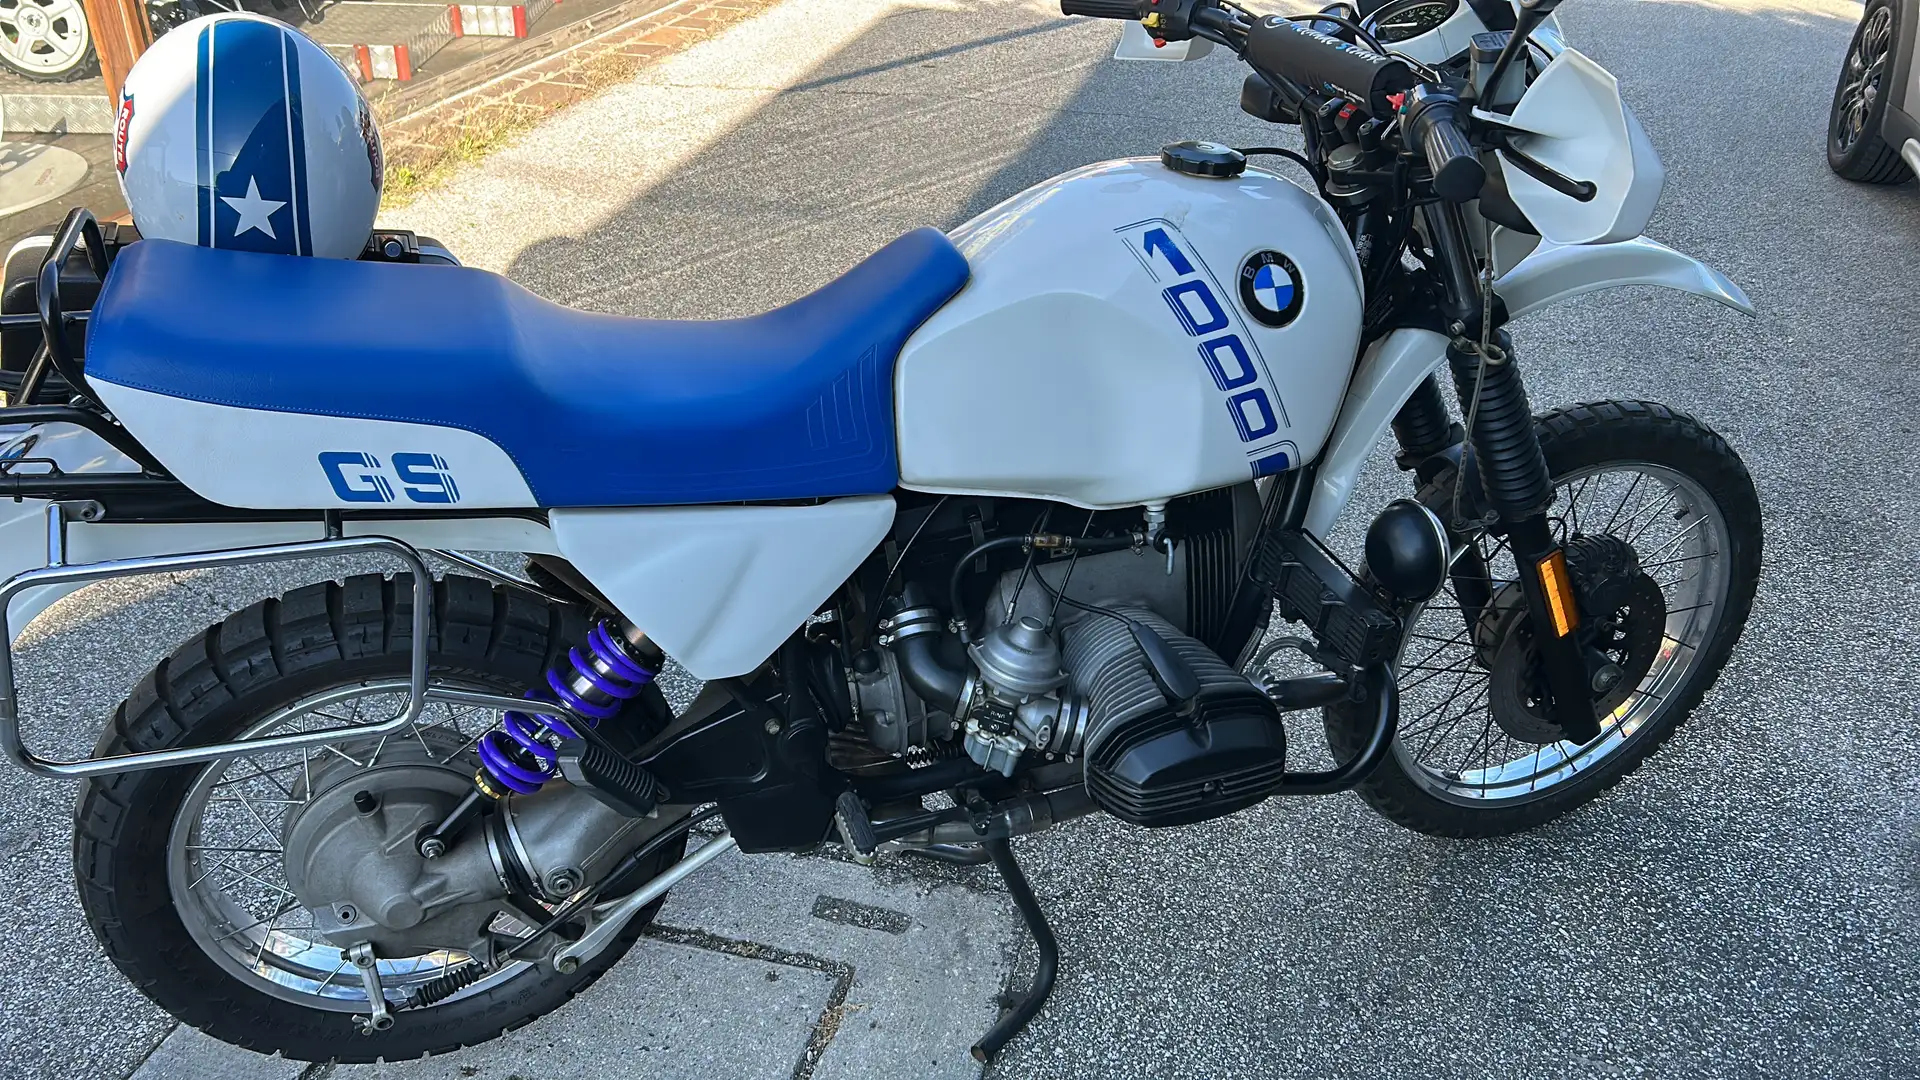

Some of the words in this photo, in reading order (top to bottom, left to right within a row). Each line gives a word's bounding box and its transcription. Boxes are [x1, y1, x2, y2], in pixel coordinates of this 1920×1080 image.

[117, 108, 130, 162] ROUTE
[1243, 252, 1296, 279] BMW
[1141, 227, 1279, 443] 1000
[318, 451, 461, 504] GS
